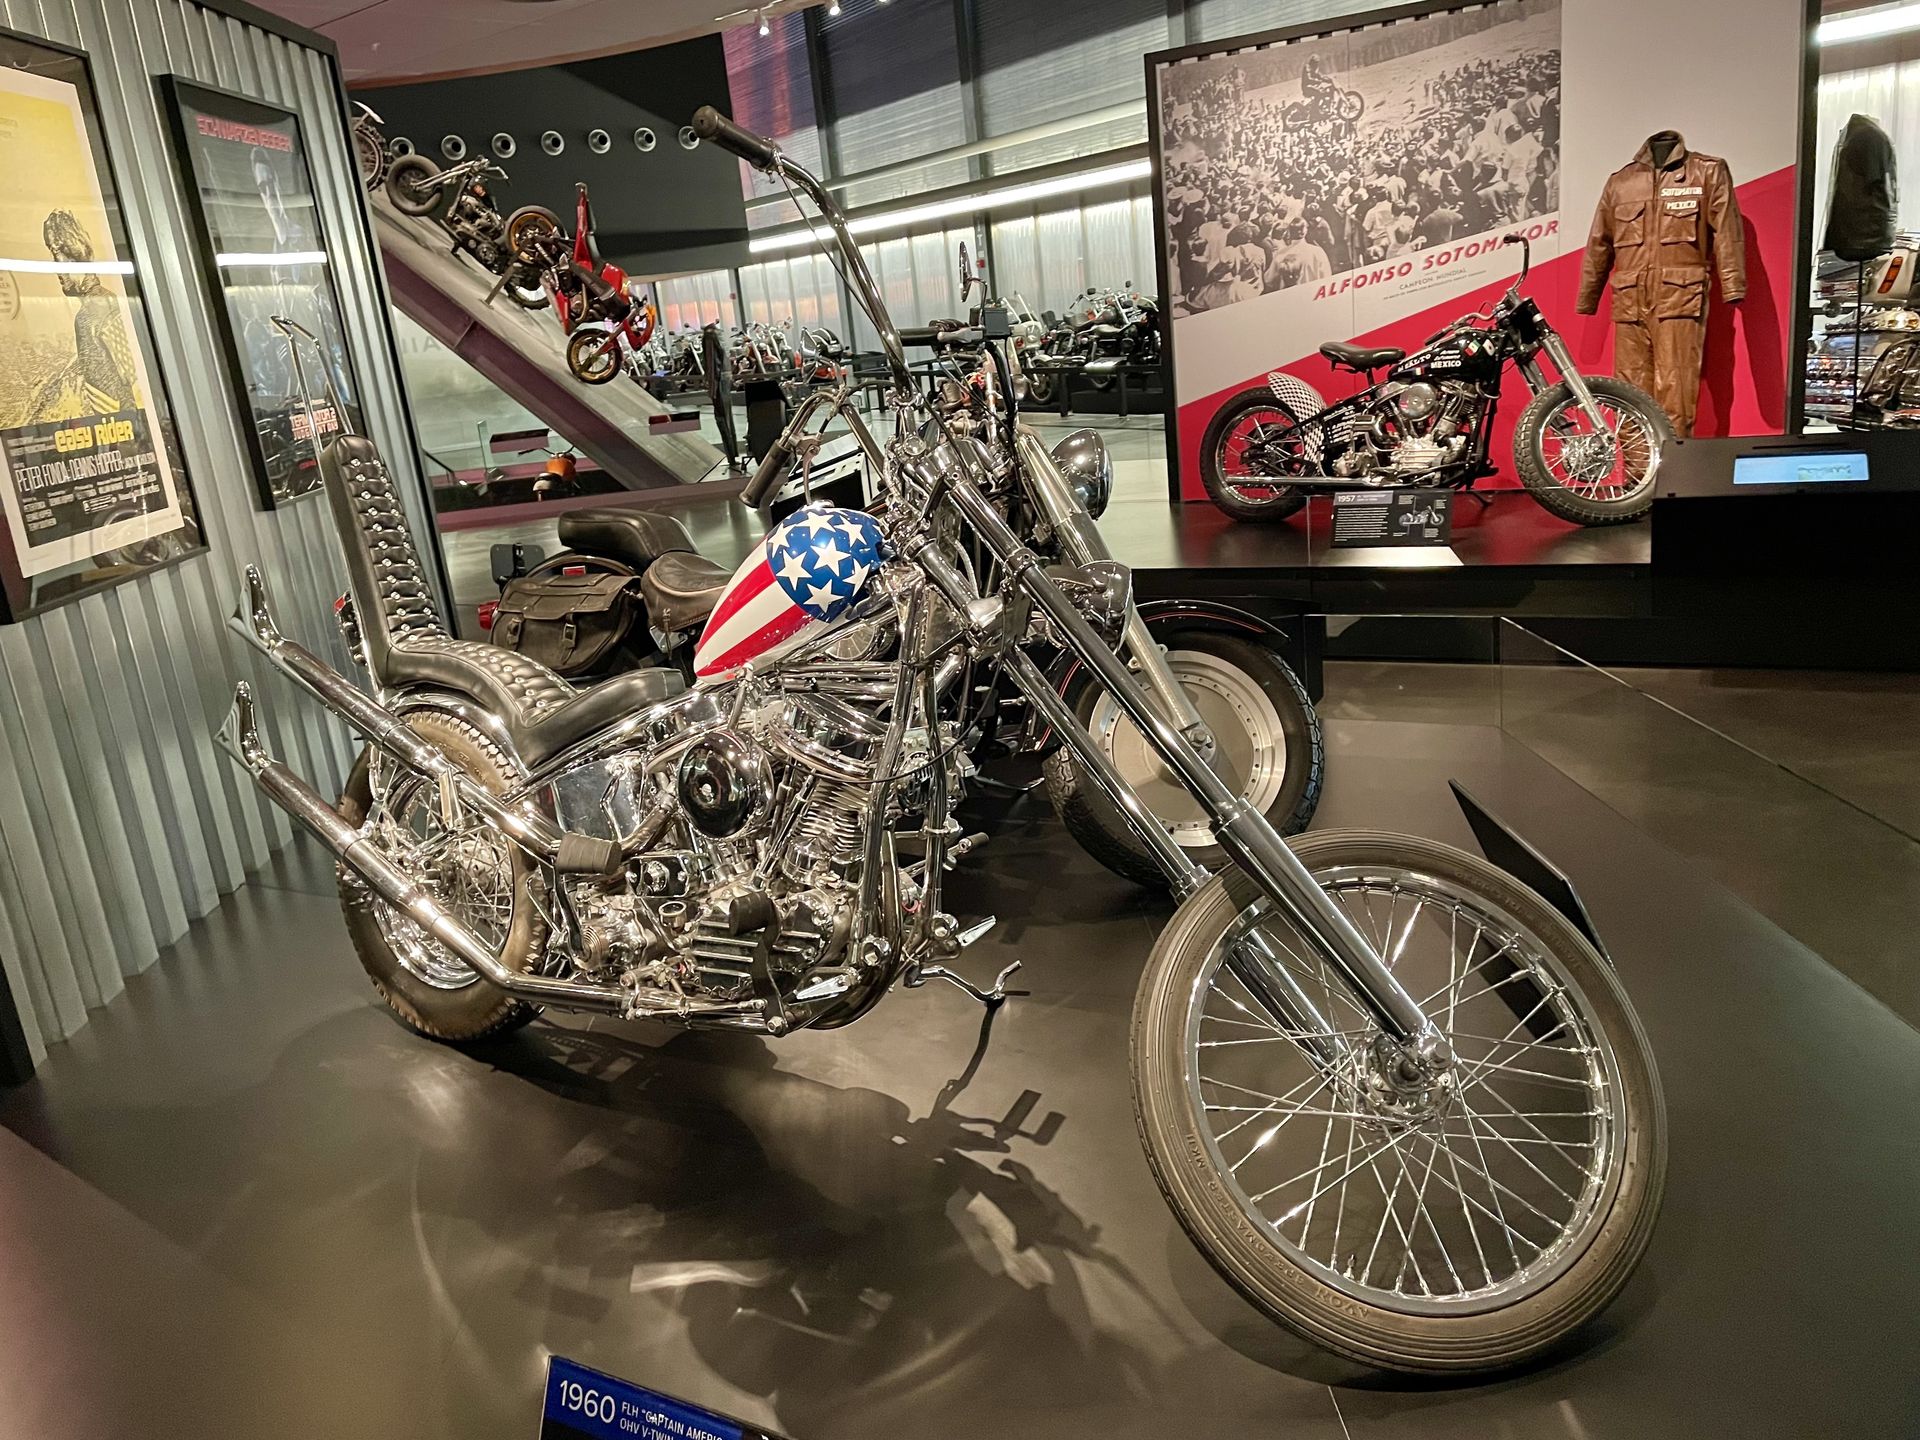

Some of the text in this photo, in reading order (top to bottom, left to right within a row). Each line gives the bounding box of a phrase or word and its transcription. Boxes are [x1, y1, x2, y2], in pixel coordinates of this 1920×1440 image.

[1313, 220, 1559, 300] ALFONSO SOTOMOR
[1430, 360, 1462, 369] MEXICO
[15, 465, 44, 493] PETER
[1338, 494, 1356, 503] 1957
[1314, 1286, 1370, 1319] AVON
[559, 1378, 616, 1424] 1960
[621, 1401, 639, 1418] FLH
[685, 1425, 723, 1440] AMER
[619, 1417, 641, 1434] OHV
